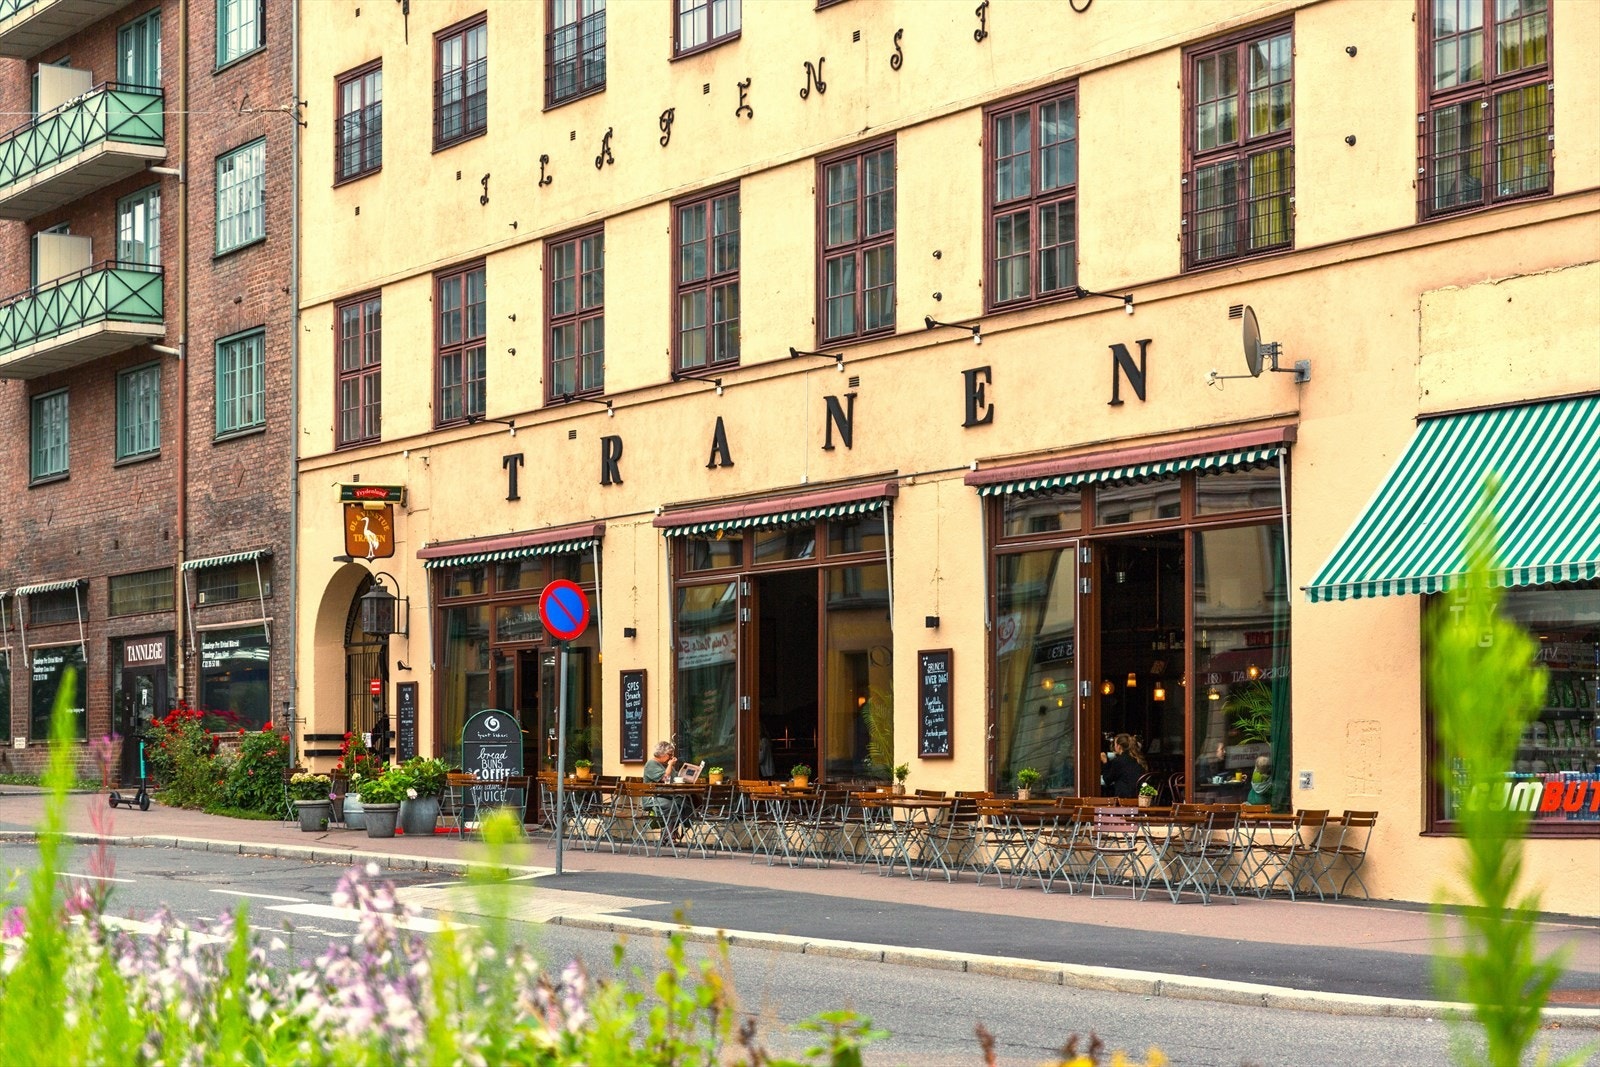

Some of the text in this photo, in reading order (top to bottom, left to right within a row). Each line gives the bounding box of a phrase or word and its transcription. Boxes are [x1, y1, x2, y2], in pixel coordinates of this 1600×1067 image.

[503, 339, 1152, 502] TRANEN
[127, 642, 163, 662] TANNLEGE
[927, 661, 945, 673] BRUNCH
[627, 682, 640, 692] SPIS
[477, 747, 508, 760] bread
[481, 759, 504, 769] BUNS
